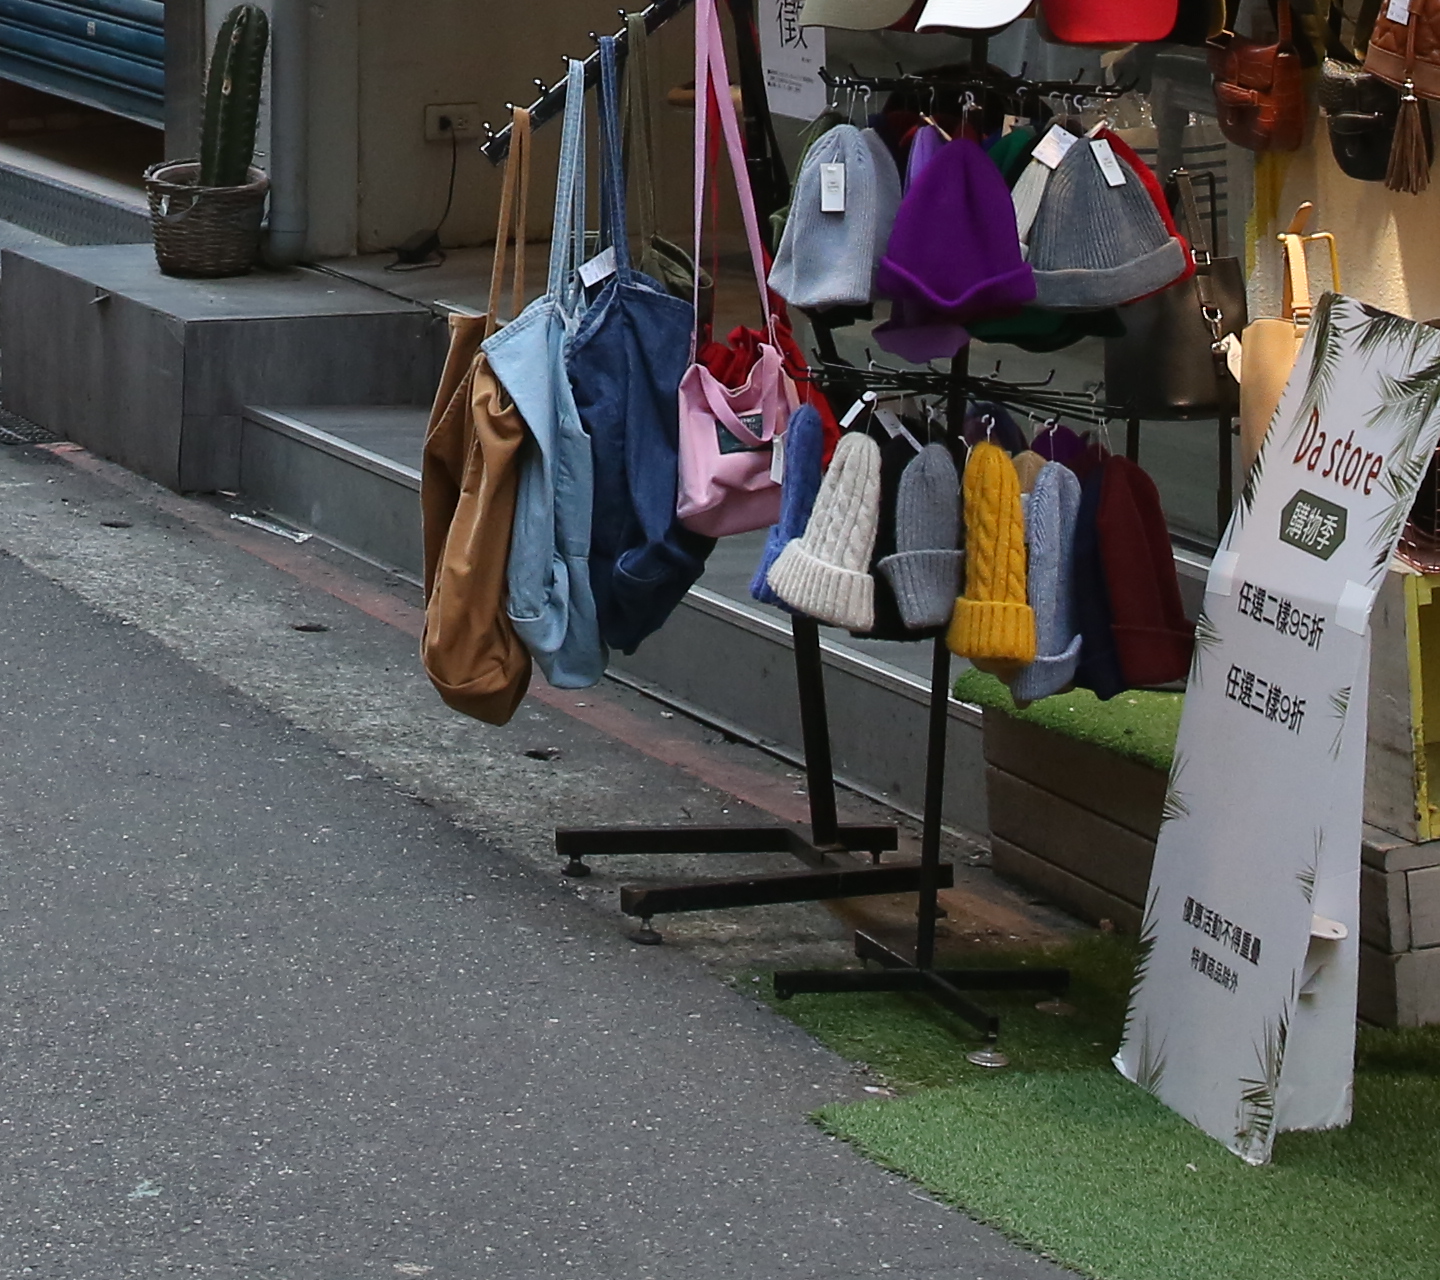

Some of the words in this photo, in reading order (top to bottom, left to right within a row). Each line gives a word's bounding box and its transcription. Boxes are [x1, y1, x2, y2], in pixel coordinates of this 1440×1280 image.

[1292, 406, 1327, 472] Da
[1321, 429, 1384, 496] store
[1285, 501, 1339, 551] 購物季
[1237, 580, 1326, 652] 任選二樣95折
[1225, 663, 1307, 736] 任選三樣9折
